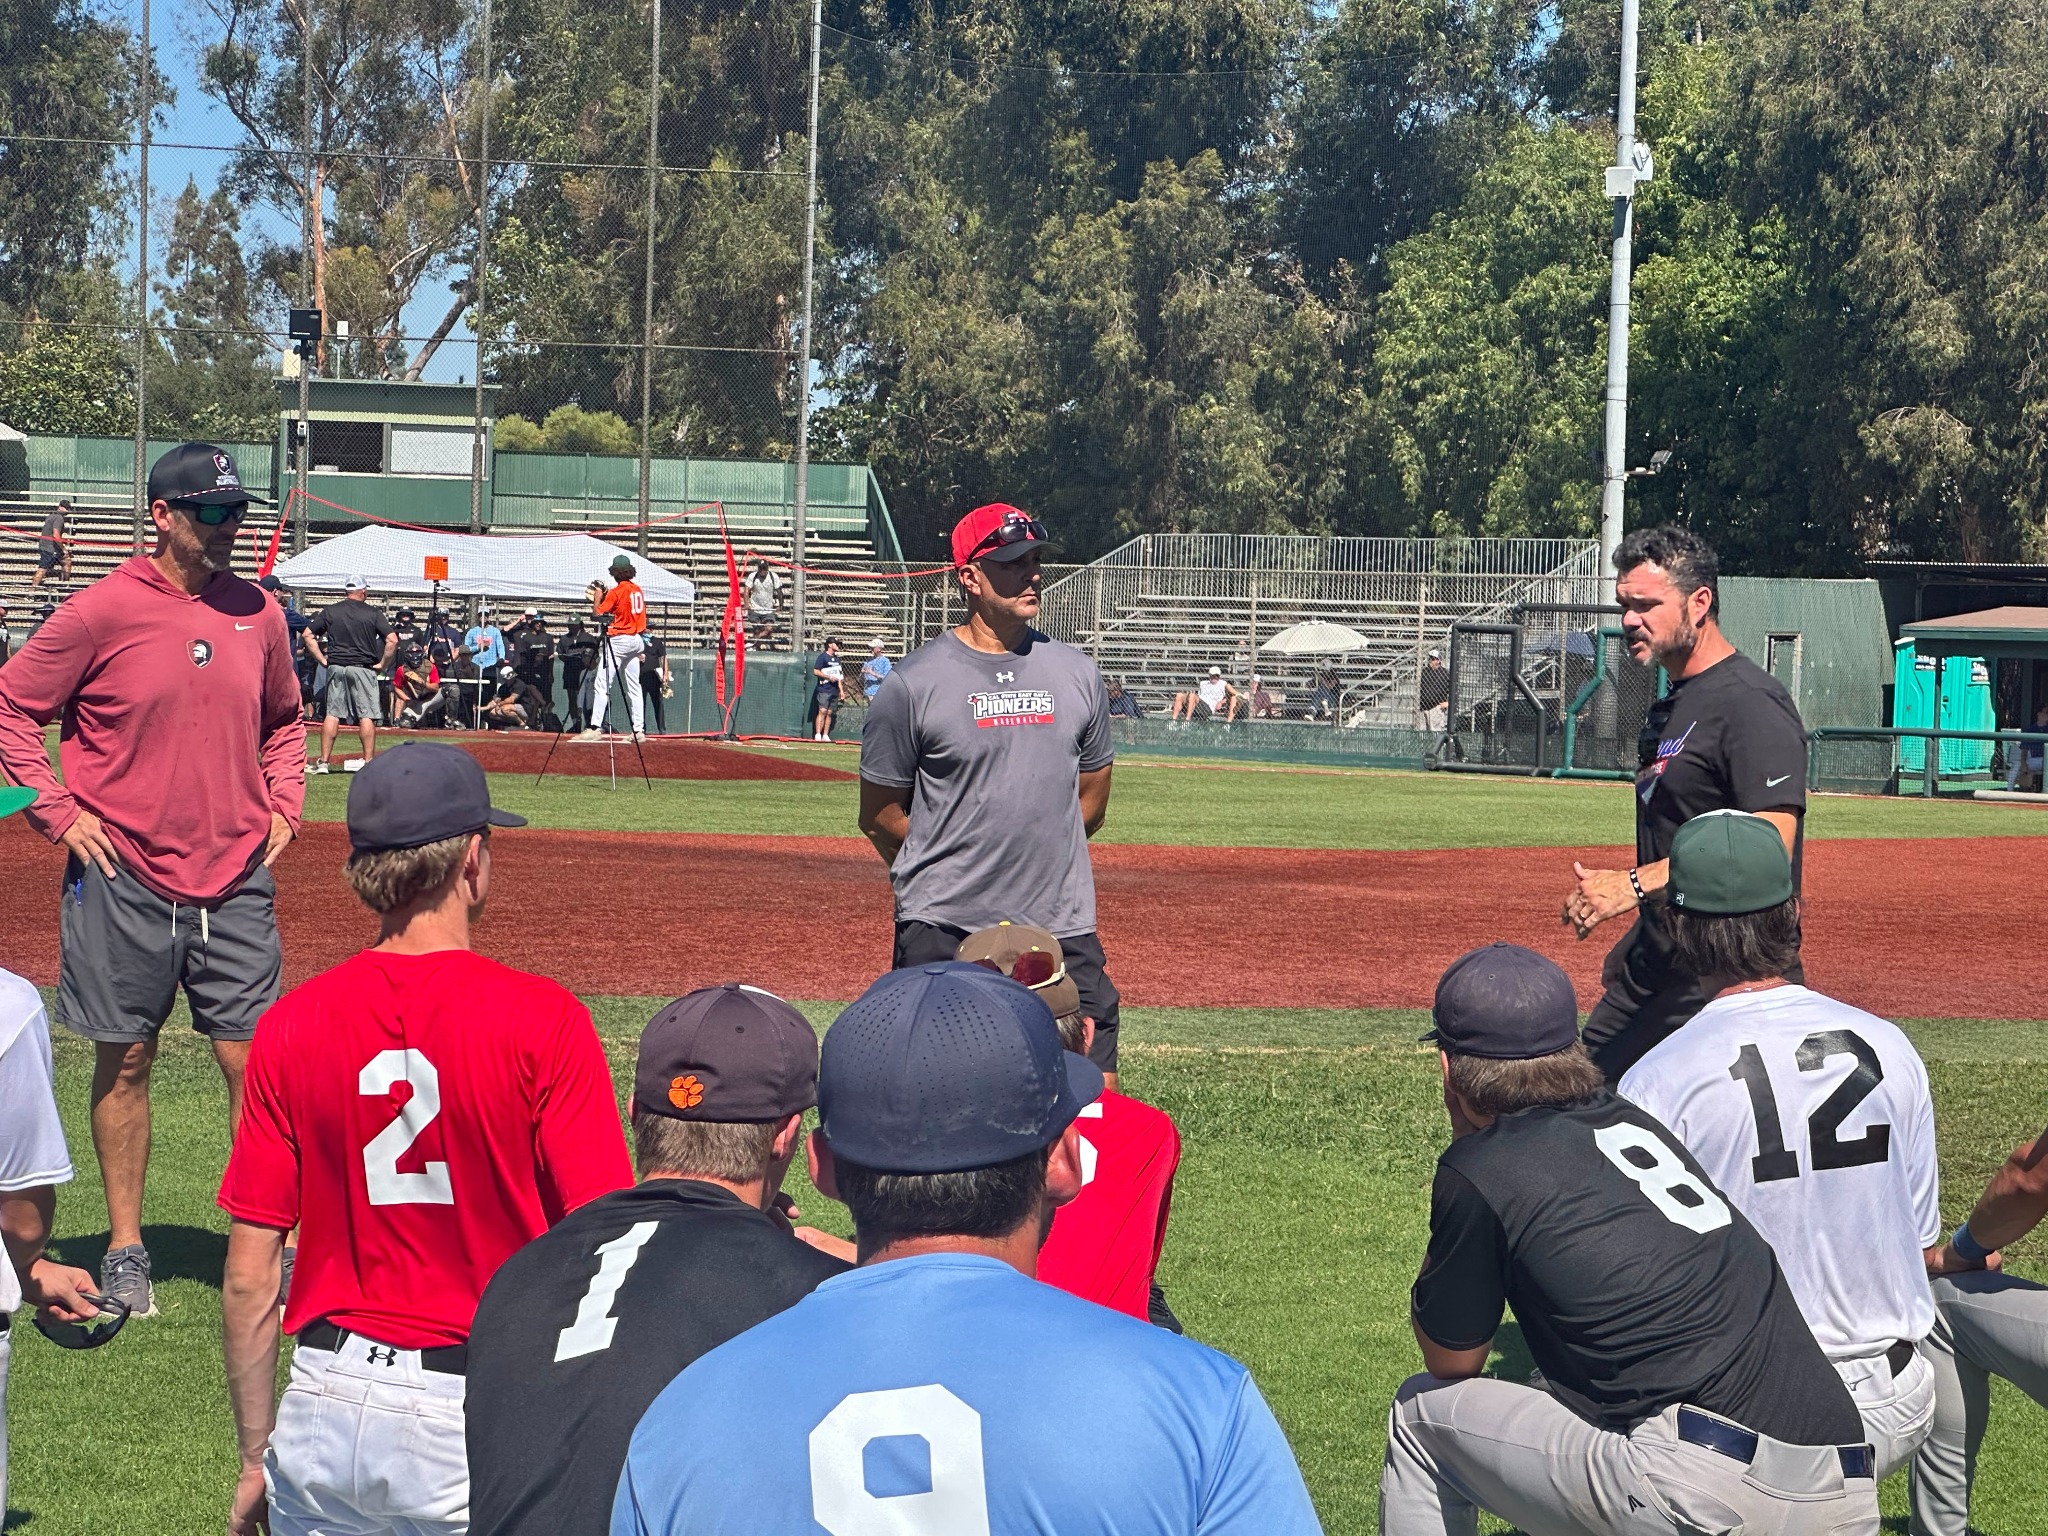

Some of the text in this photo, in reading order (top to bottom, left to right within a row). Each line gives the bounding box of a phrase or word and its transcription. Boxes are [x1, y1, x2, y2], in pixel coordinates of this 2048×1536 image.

[630, 591, 644, 614] 10
[976, 694, 1052, 717] PIONEERS
[359, 1048, 454, 1205] 2
[1728, 1029, 1890, 1184] 12
[1593, 1121, 1732, 1234] 8
[554, 1221, 660, 1362] 1
